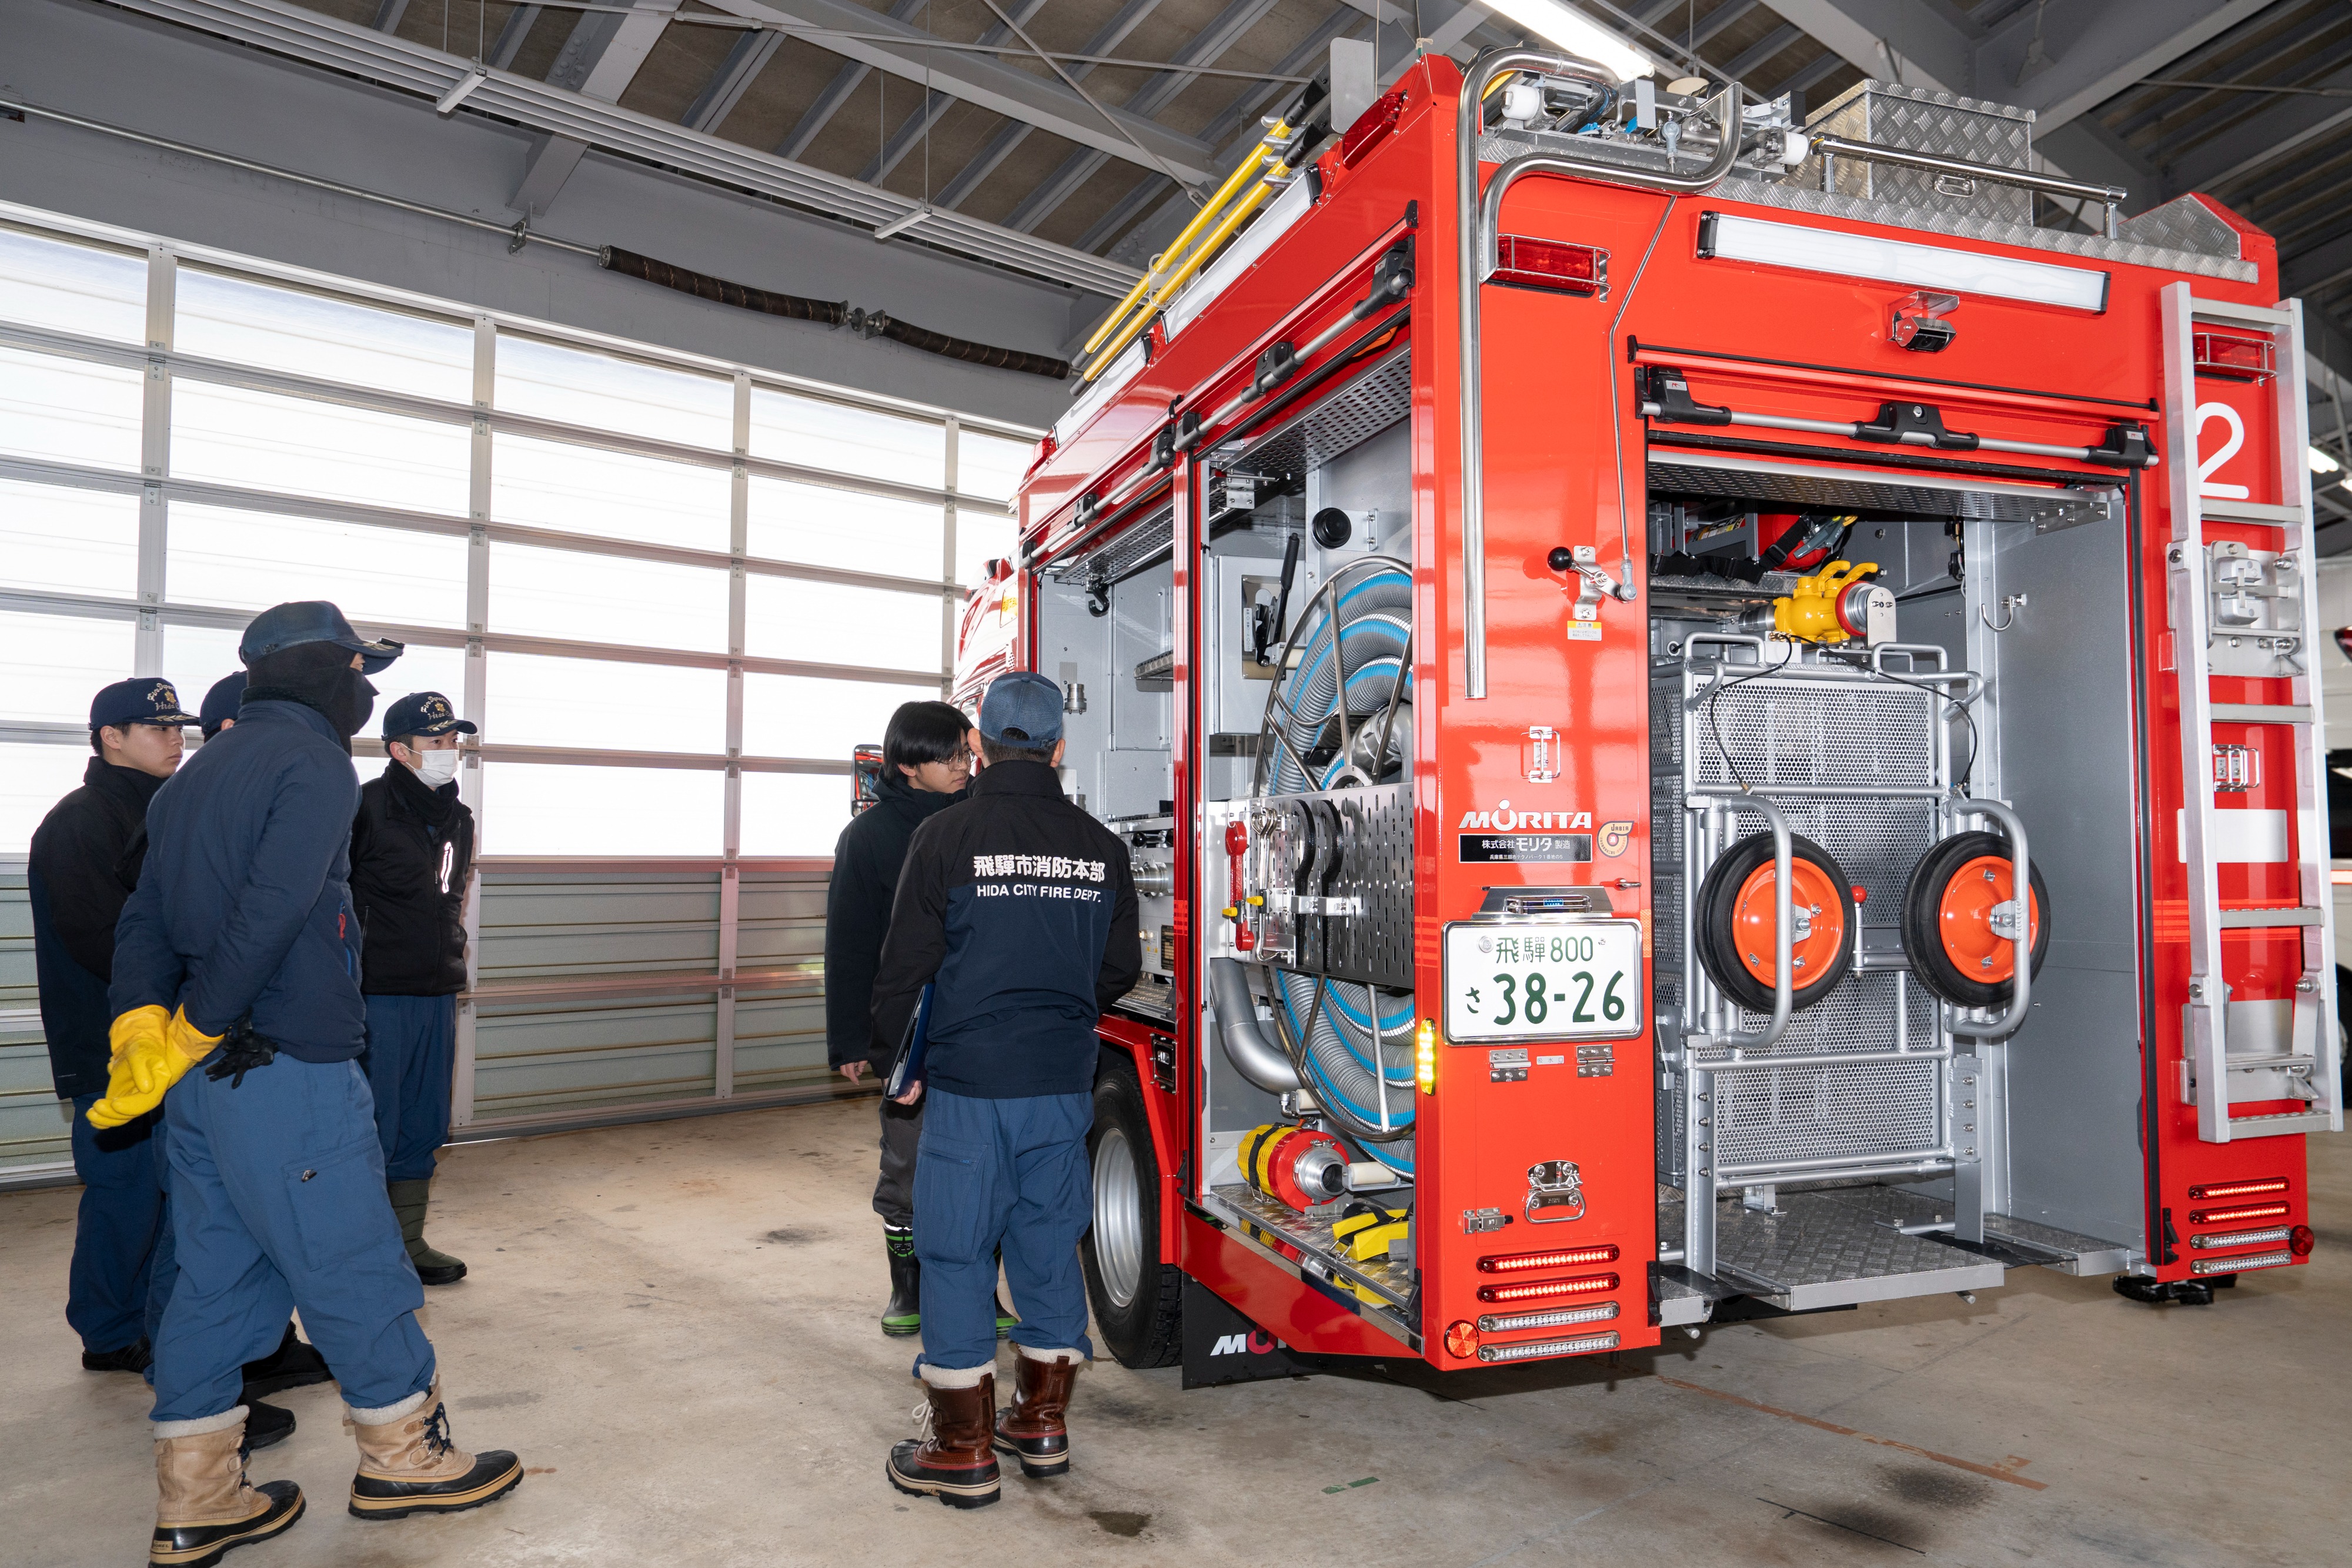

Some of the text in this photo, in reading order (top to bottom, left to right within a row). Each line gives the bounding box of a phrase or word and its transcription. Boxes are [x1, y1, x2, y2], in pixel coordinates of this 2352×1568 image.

[2196, 402, 2249, 499] 2
[1458, 799, 1592, 831] MORITA
[977, 884, 1101, 902] HIDA CITY FIRE DEPT.
[1550, 936, 1593, 962] 800
[1465, 970, 1625, 1025] さ 38-26
